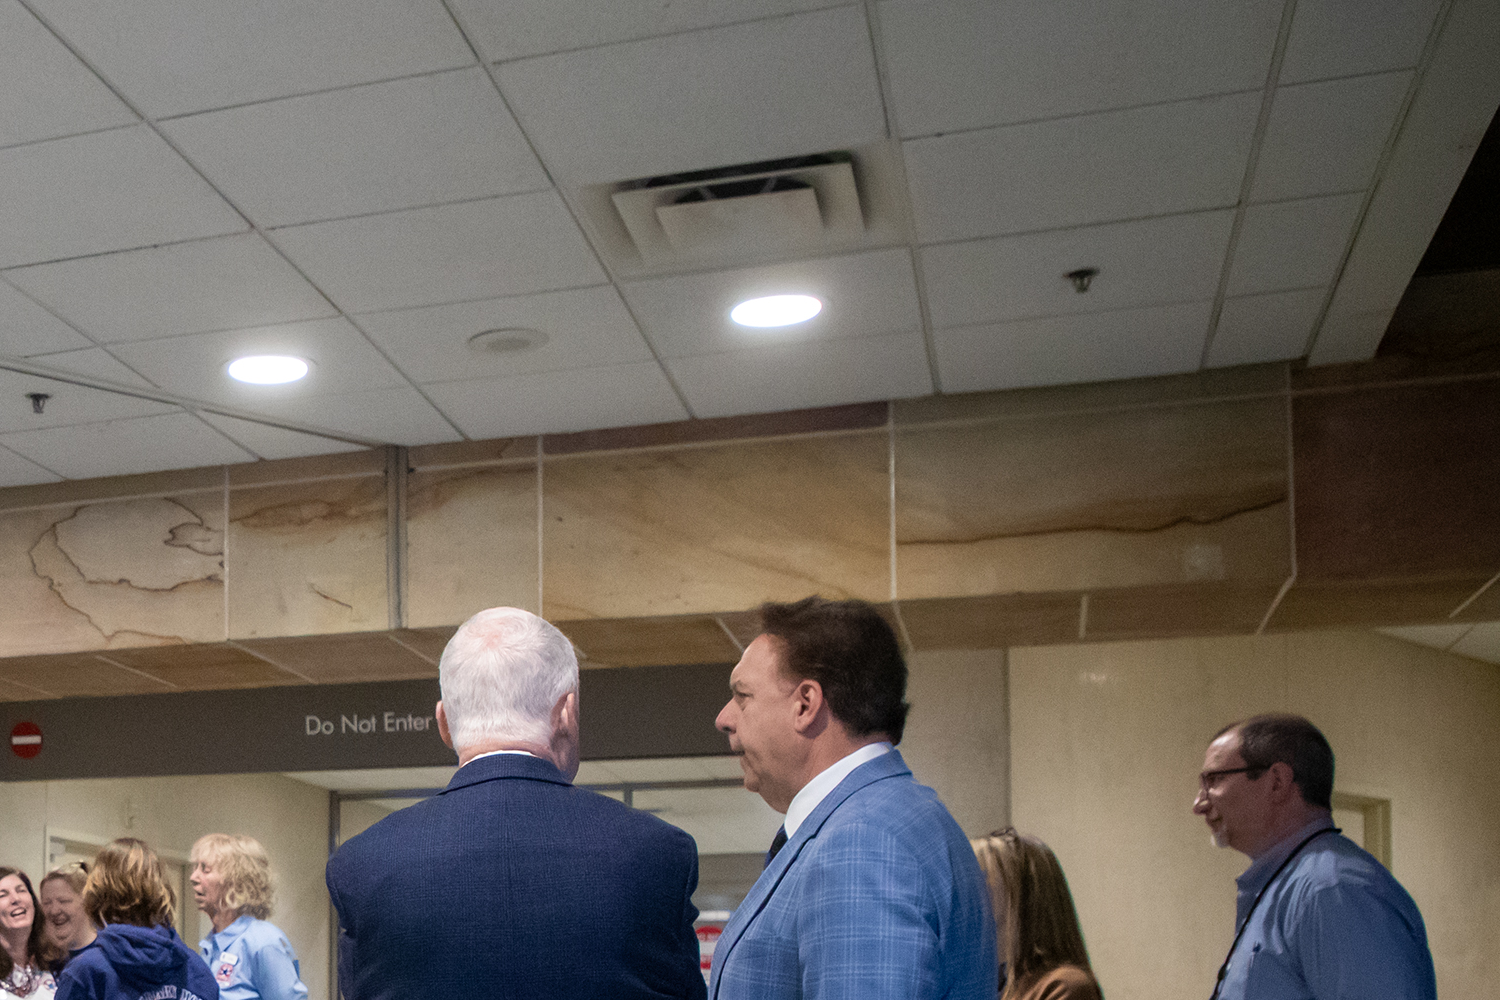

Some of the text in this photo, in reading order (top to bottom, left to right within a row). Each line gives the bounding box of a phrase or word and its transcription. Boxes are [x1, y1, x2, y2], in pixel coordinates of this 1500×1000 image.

[305, 711, 433, 736] Do Not Enter
